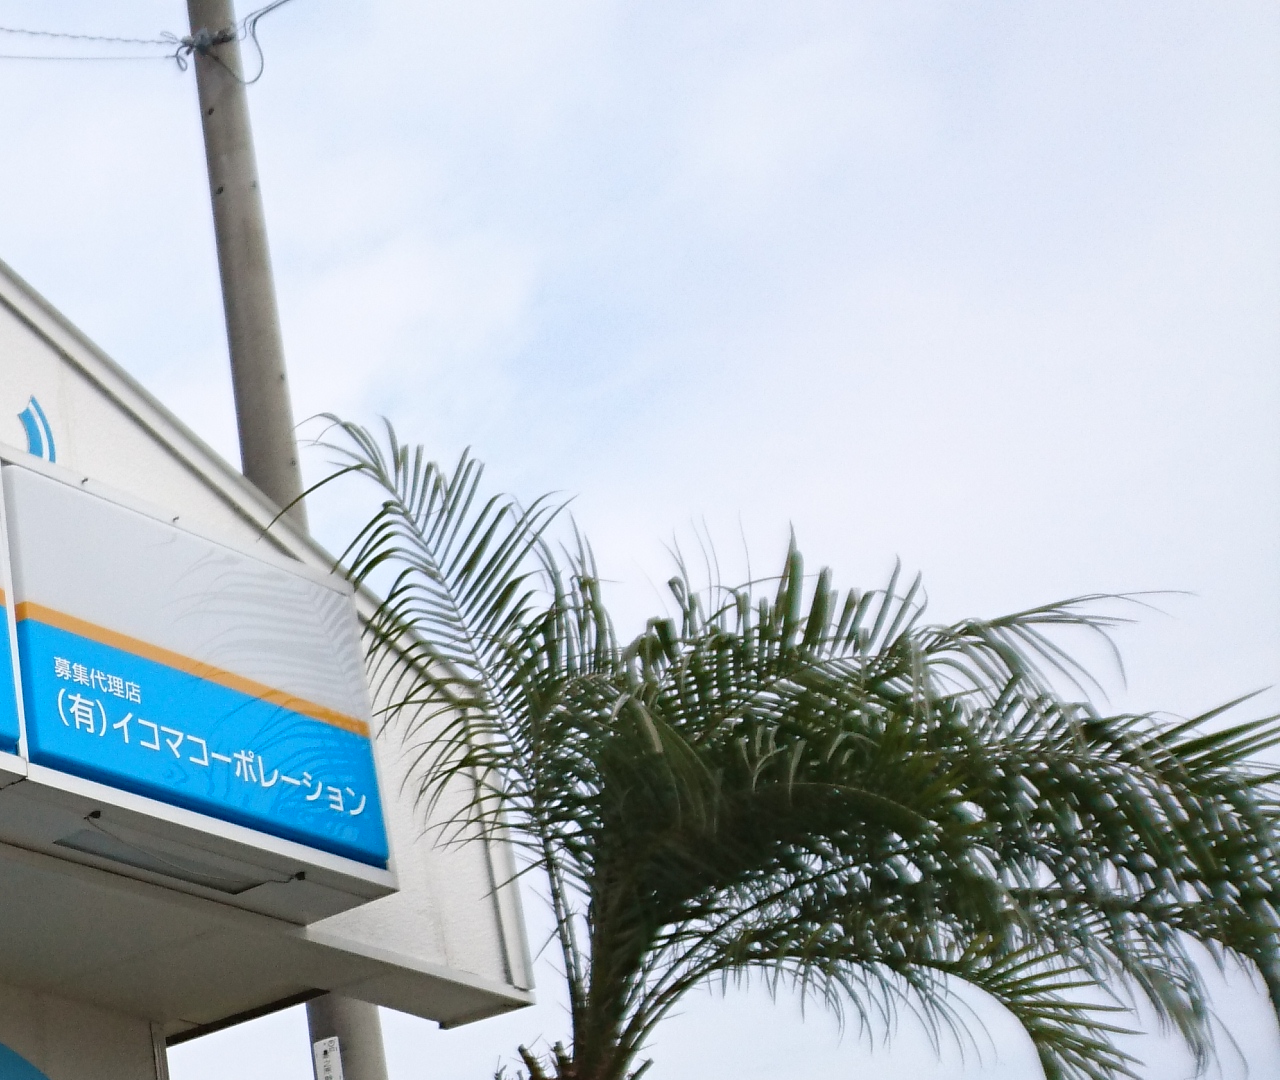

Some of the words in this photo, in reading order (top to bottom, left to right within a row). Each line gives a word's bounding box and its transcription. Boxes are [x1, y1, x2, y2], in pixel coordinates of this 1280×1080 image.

[53, 656, 142, 705] 募集代理店
[57, 688, 366, 816] (有)イコマコーポレーション
